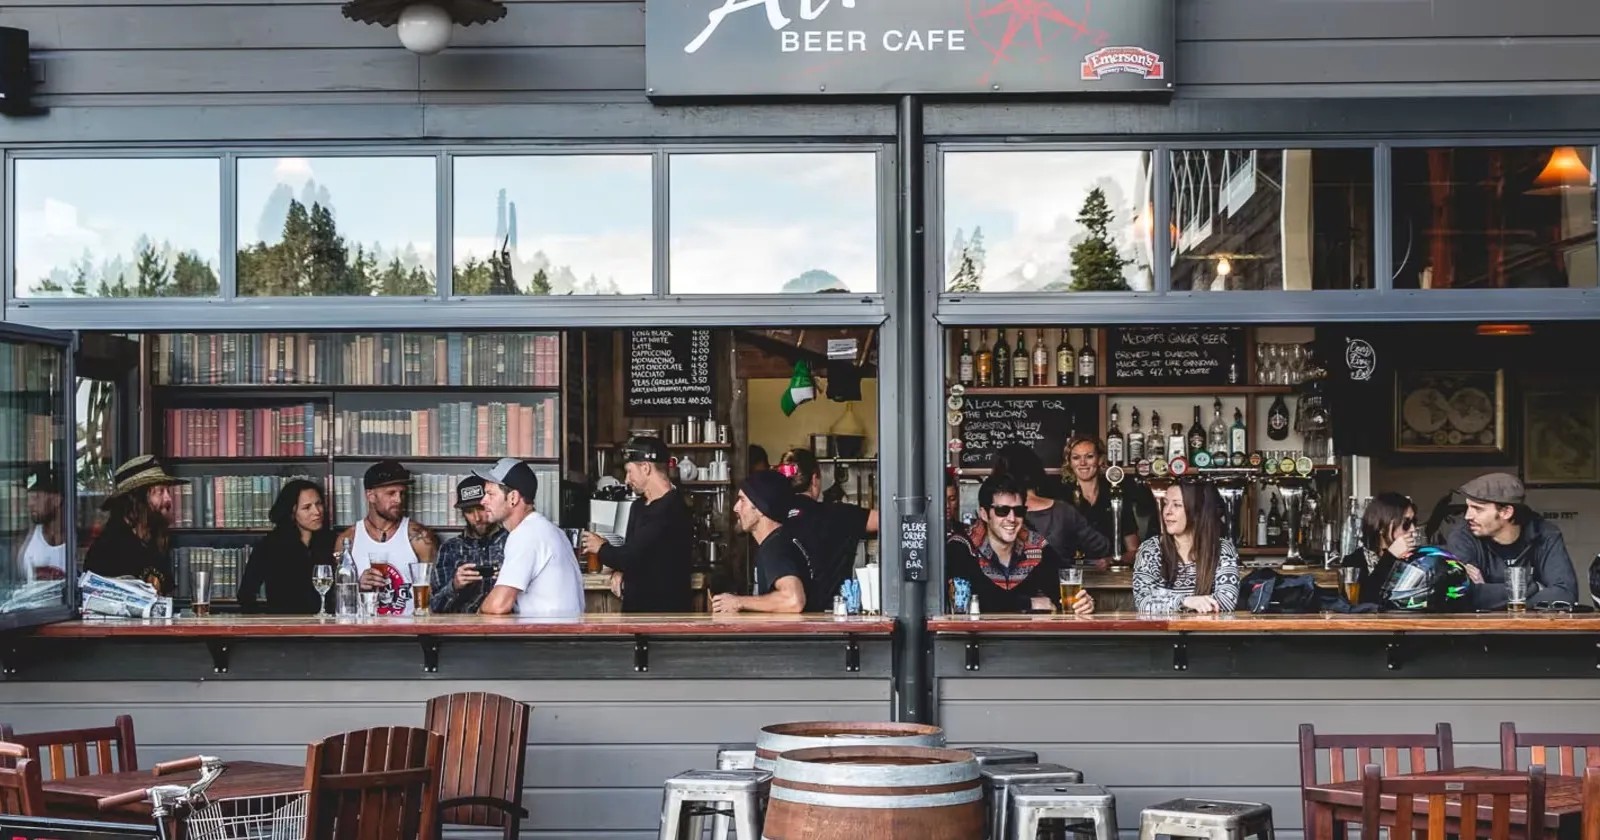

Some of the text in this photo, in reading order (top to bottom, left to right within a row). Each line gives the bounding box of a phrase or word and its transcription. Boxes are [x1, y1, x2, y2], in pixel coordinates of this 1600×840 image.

[781, 30, 966, 52] BEER CAFE
[1092, 53, 1154, 67] Emerson's
[1201, 333, 1228, 344] BEER
[645, 363, 683, 371] CHOCOLATE
[631, 370, 665, 378] MACCIATO
[1116, 368, 1144, 377] RECIPE
[632, 379, 650, 387] TEAS
[652, 397, 672, 405] LARGE
[965, 398, 1066, 411] A LOCAL TREAT FOR
[985, 410, 1028, 418] HOLIDAYS
[901, 522, 927, 531] PLEASE
[903, 531, 927, 540] ORDER
[901, 540, 924, 549] INSIDE
[905, 559, 923, 569] BAR
